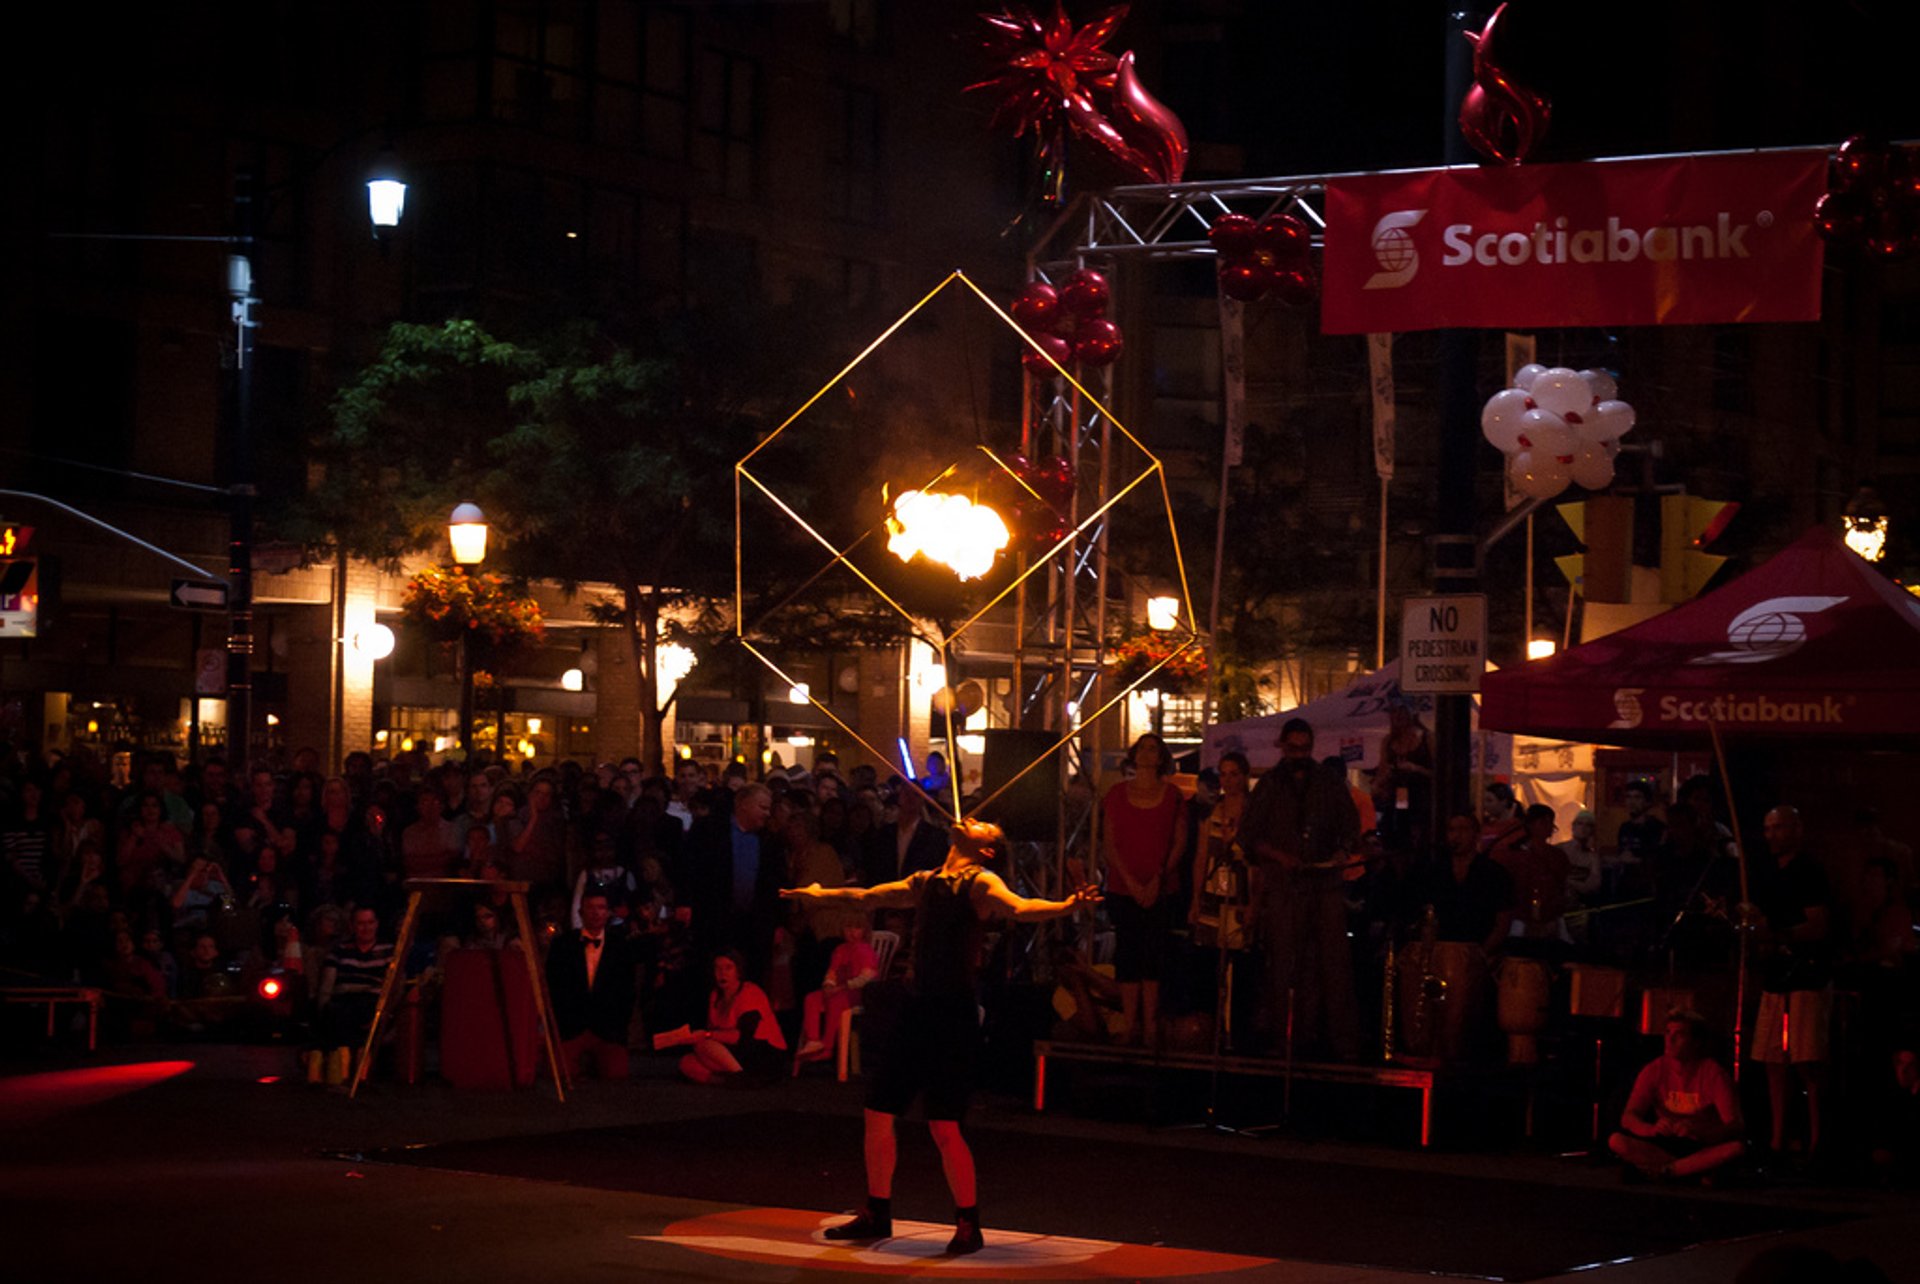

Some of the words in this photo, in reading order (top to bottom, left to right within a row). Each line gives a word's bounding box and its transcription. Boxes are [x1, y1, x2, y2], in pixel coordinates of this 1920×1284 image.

[1430, 606, 1458, 632] NO
[1408, 638, 1478, 658] PEDESTRIAN
[1414, 663, 1471, 683] CROSSING
